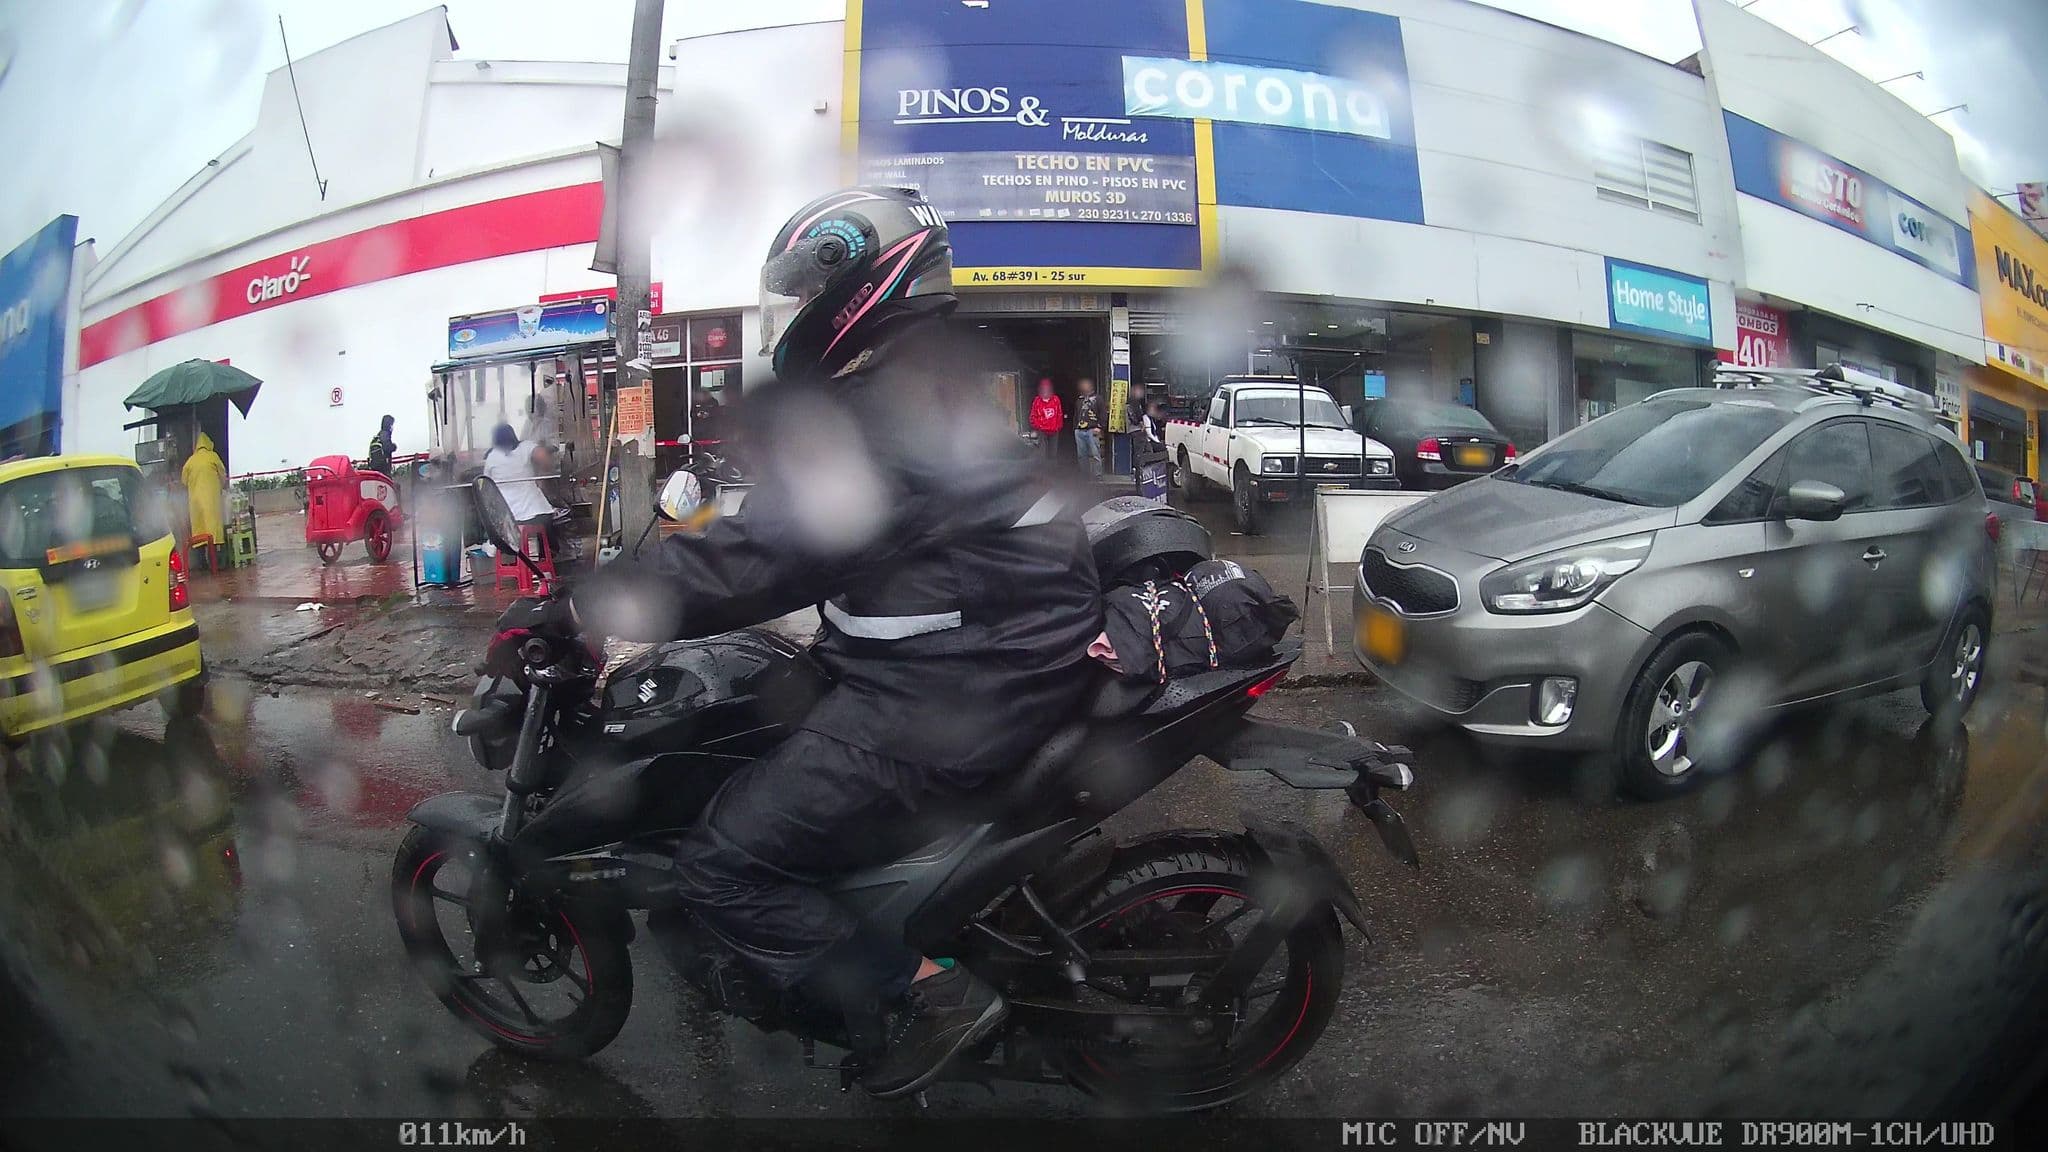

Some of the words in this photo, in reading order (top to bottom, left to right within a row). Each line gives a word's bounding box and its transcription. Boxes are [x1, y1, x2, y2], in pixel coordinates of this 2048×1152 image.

[1133, 67, 1382, 127] corona
[898, 87, 1010, 116] PINOS
[1016, 96, 1050, 127] &
[1062, 122, 1149, 144] Molduras
[893, 156, 945, 167] LAMINADOS
[1015, 155, 1079, 171] TECHO
[1086, 156, 1112, 171] EN
[1117, 157, 1154, 173] PVC
[982, 175, 1032, 186] TECHOS
[1036, 175, 1053, 186] EN
[1056, 175, 1089, 187] PINO
[1102, 178, 1139, 188] PISOS
[1141, 178, 1159, 190] EN
[1162, 180, 1187, 191] PVC
[1045, 190, 1101, 204] MUROS
[1106, 192, 1127, 204] 3D
[1078, 208, 1100, 219] 230
[1103, 209, 1130, 220] 9231
[1140, 210, 1162, 221] 270
[1165, 212, 1192, 223] 1336
[973, 271, 989, 282] Av.
[1051, 271, 1065, 281] 25
[1068, 272, 1086, 281] sur
[246, 270, 301, 305] Claro
[1615, 279, 1664, 311] Home
[1668, 290, 1706, 324] Style
[1737, 314, 1776, 334] OMBOS
